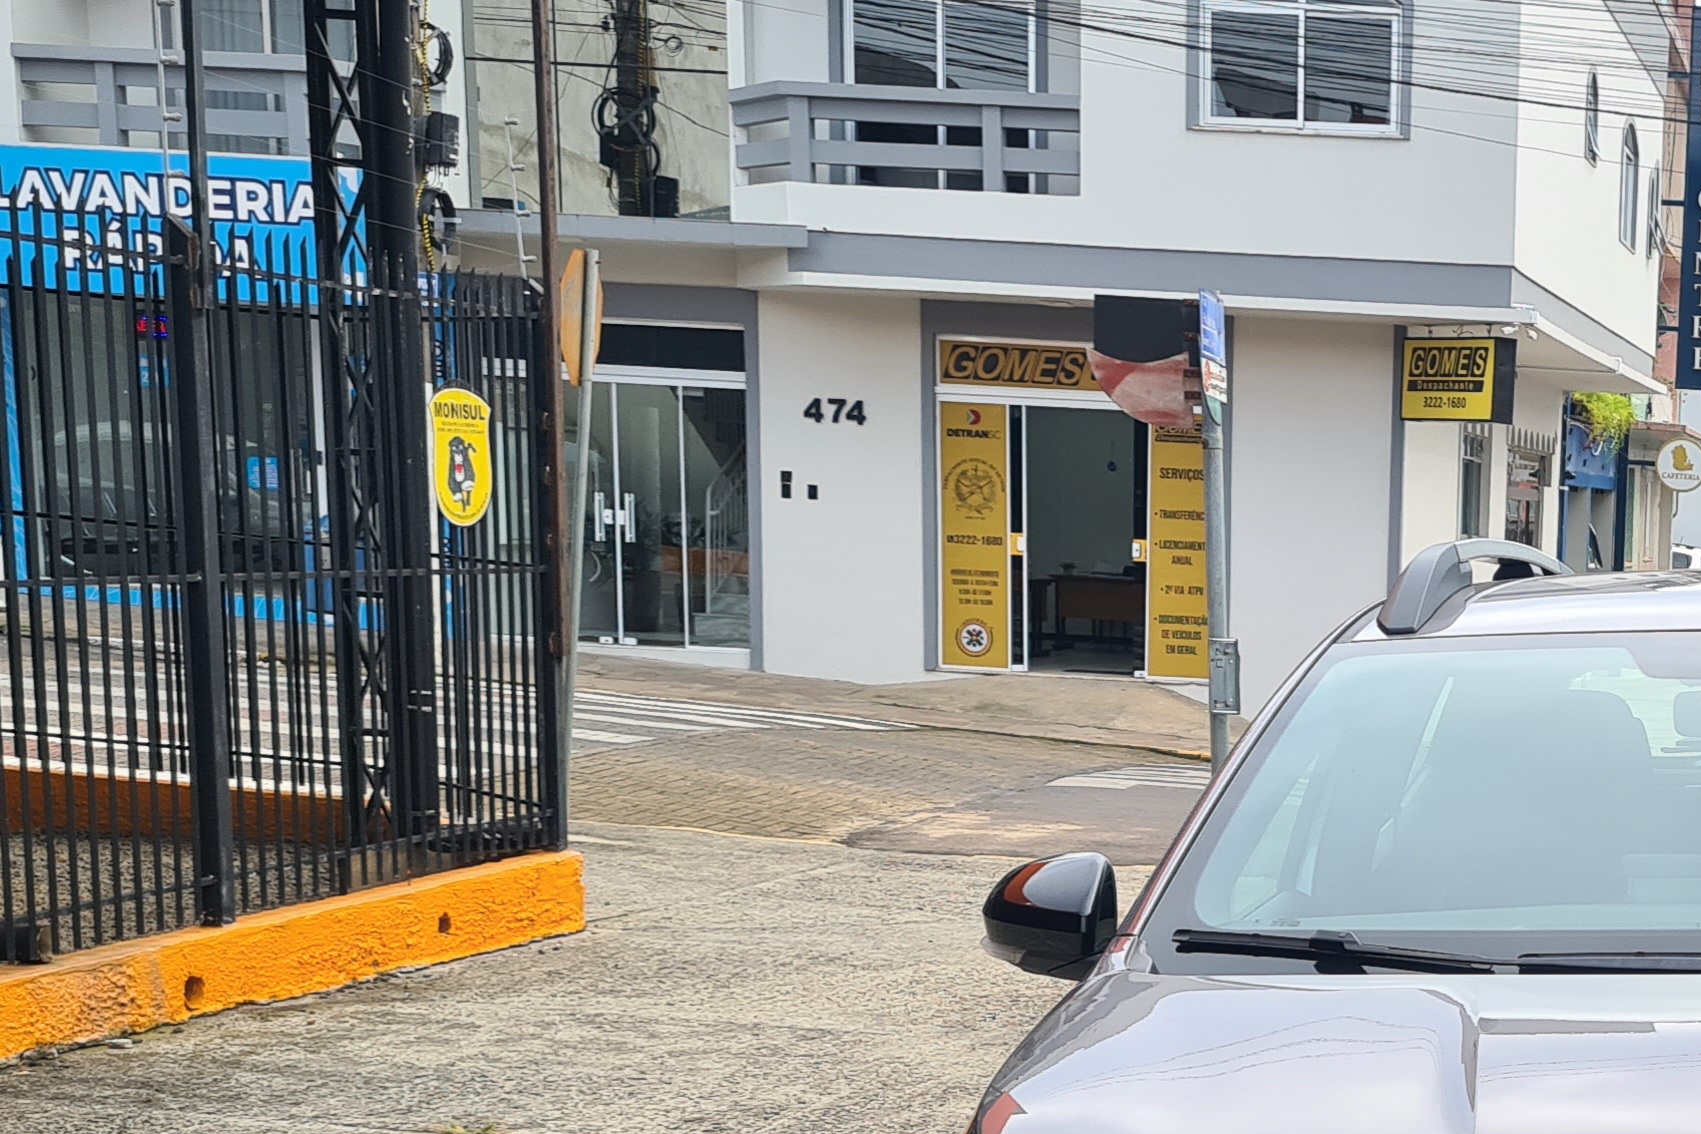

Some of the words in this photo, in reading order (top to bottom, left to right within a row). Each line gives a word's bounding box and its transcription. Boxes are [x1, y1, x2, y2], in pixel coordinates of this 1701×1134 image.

[0, 168, 314, 223] AVANDERIA
[63, 219, 266, 279] RÁPA
[946, 345, 1086, 386] GOMES
[1410, 348, 1488, 376] GOMES
[1416, 380, 1475, 391] Despachante
[1422, 396, 1467, 409] 3222-1680
[433, 401, 486, 421] MONISUL
[803, 397, 867, 426] 474
[1159, 467, 1205, 482] SERVIÇOS
[1661, 471, 1700, 481] CAFETERIA
[1159, 508, 1205, 521] TRANSFERÊNC
[1159, 539, 1206, 551] LICENCIAMENT
[1158, 613, 1208, 627] DOCUMENTAÇÃ
